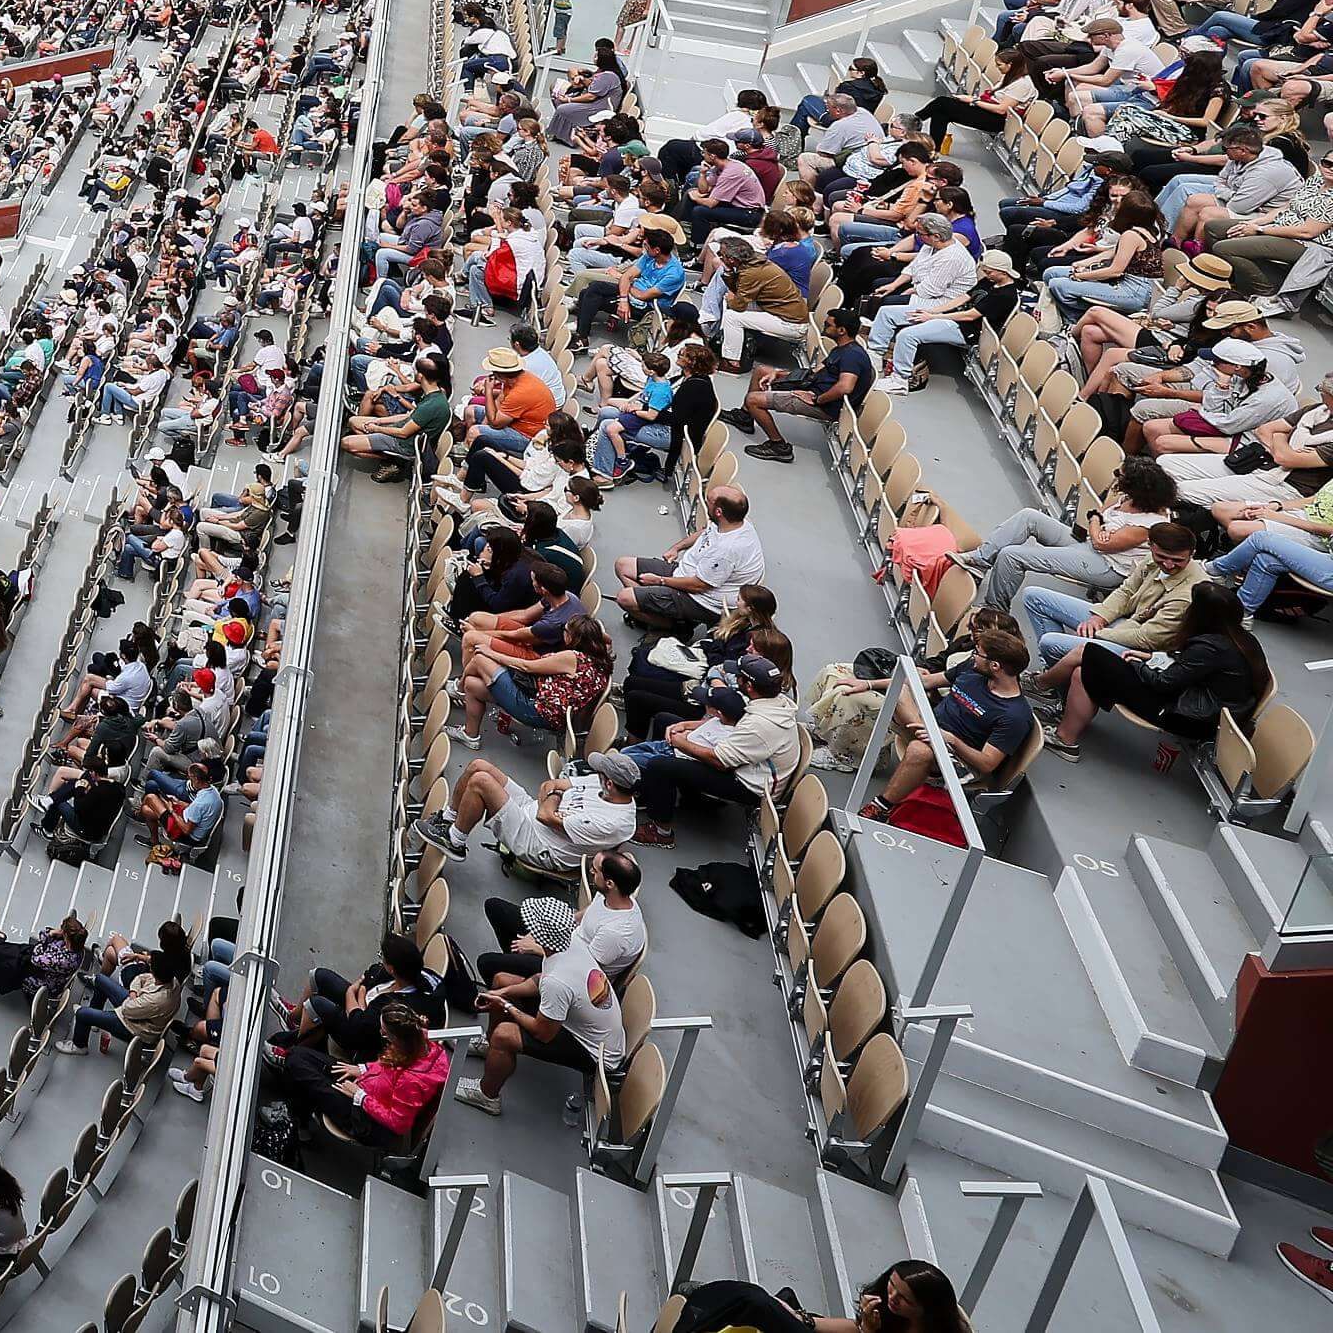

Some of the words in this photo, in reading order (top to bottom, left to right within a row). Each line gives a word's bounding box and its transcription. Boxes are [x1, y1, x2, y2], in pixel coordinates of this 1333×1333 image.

[872, 830, 917, 855] 04
[27, 865, 43, 877] 14
[124, 868, 140, 881] 15
[1072, 852, 1120, 878] 05
[226, 870, 242, 882] 16
[260, 1168, 293, 1197] 01
